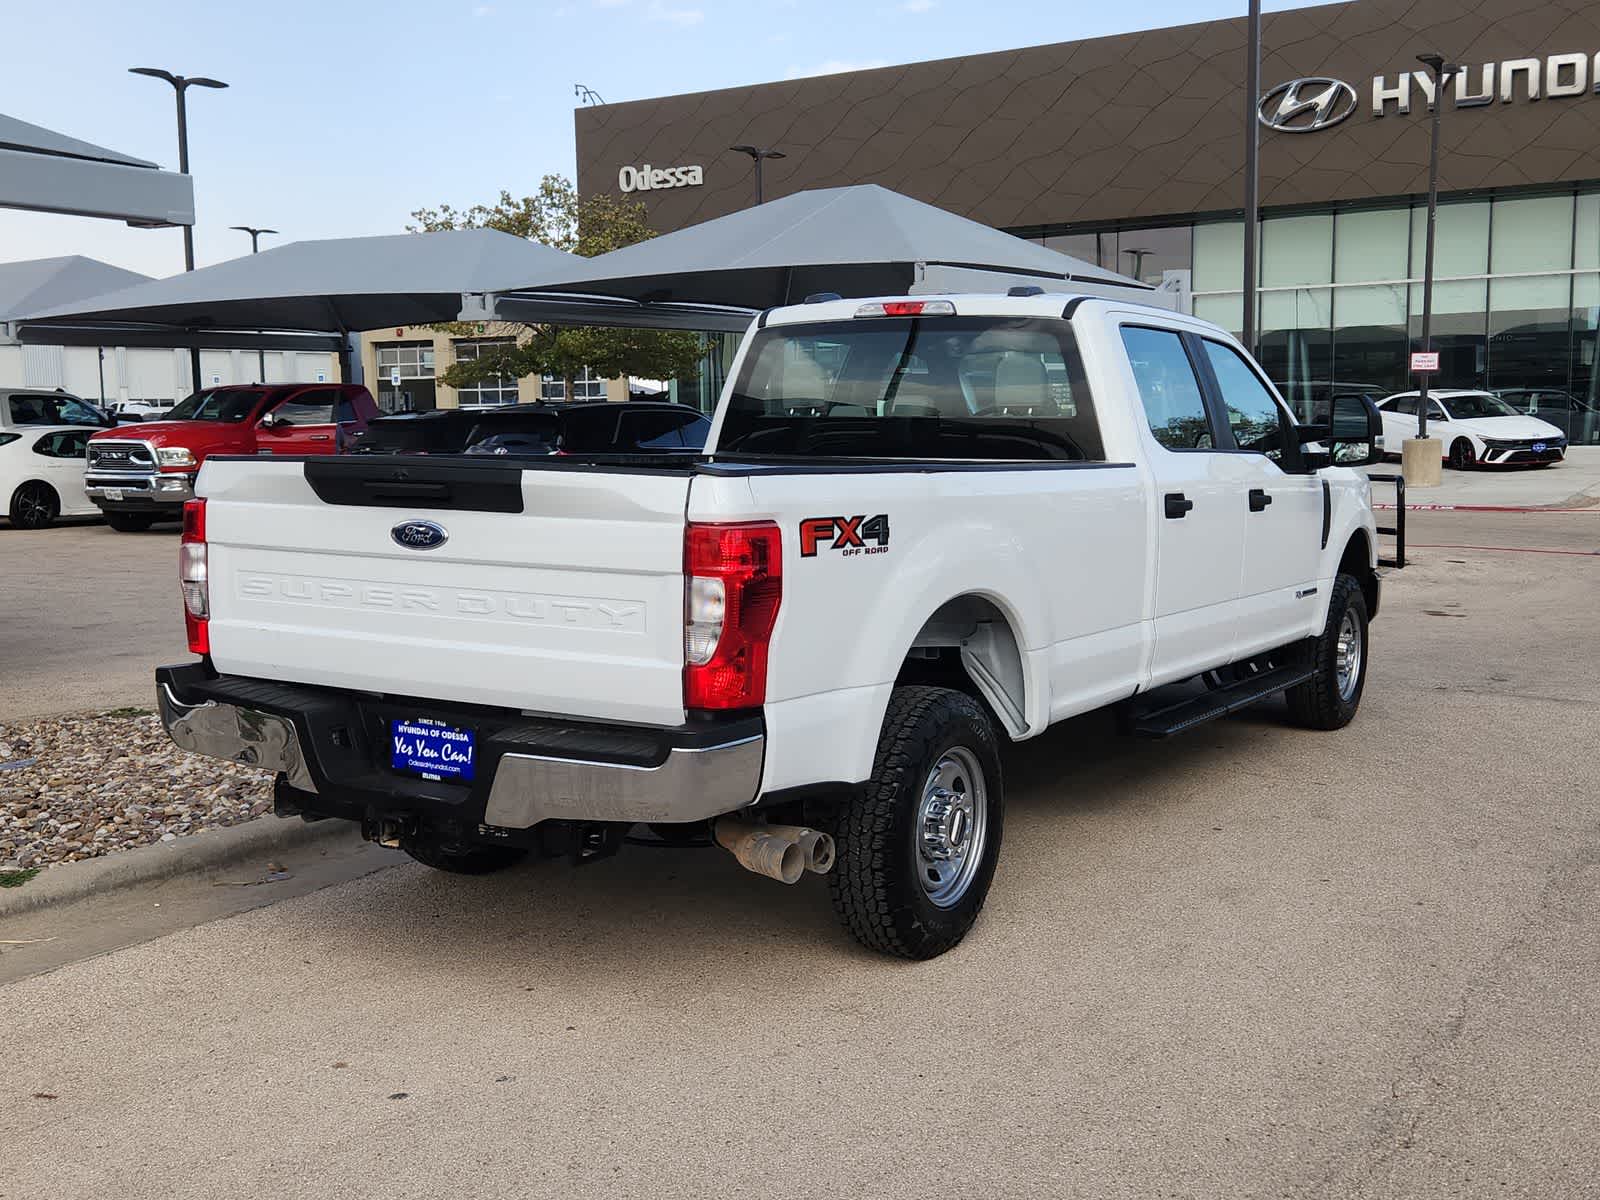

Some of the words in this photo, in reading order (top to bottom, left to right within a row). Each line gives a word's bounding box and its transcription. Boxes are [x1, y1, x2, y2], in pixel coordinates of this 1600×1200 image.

[1372, 51, 1600, 117] HYUND
[619, 164, 703, 192] Odessa
[402, 525, 433, 544] Ford
[799, 514, 889, 557] FX4
[842, 549, 862, 557] OFF
[865, 546, 889, 555] ROAD
[241, 576, 440, 611] SUPER
[456, 593, 642, 626] DUTY
[398, 725, 429, 737] HYUNDAI
[430, 730, 440, 738] OF
[441, 731, 469, 742] ODESSA
[394, 736, 414, 756] Yes
[416, 739, 439, 758] You
[441, 743, 473, 765] Can!
